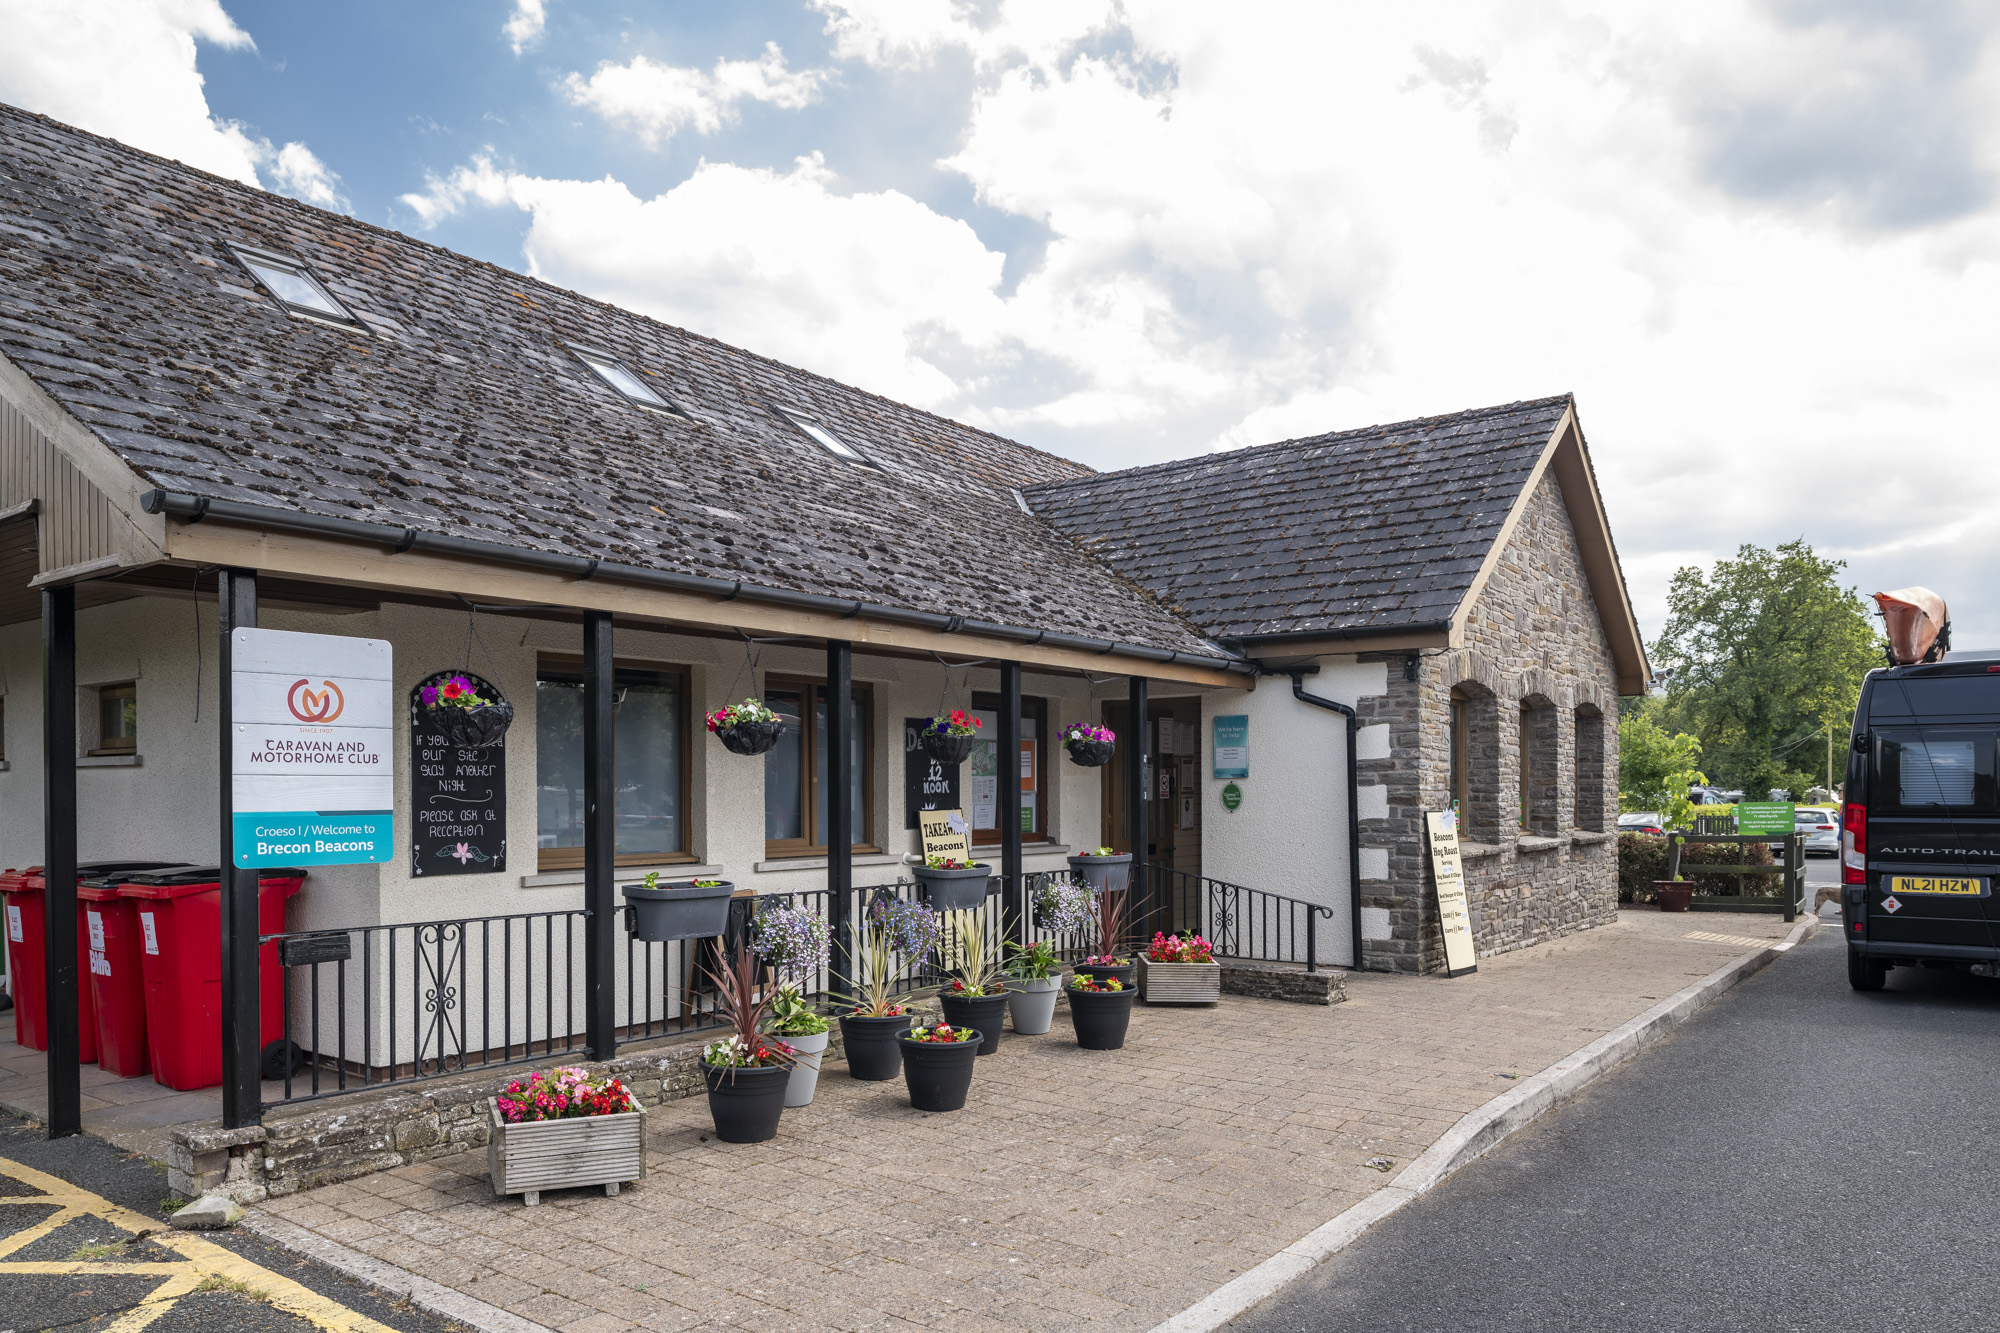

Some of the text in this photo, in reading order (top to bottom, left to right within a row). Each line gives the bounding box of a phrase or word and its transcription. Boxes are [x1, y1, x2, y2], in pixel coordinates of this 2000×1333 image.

[266, 740, 365, 752] CARAVAN AND
[250, 752, 379, 764] MOTORHOME CLUB
[928, 766, 942, 781] 12
[256, 826, 295, 837] Croeso
[311, 824, 362, 835] Welcome
[364, 824, 375, 834] to
[1433, 833, 1454, 841] Beacons
[257, 840, 374, 855] Brecon Beacons
[926, 842, 964, 852] Beacons
[1880, 847, 2000, 856] AUTO-TRAIL
[1901, 879, 1970, 892] NL21 HZW
